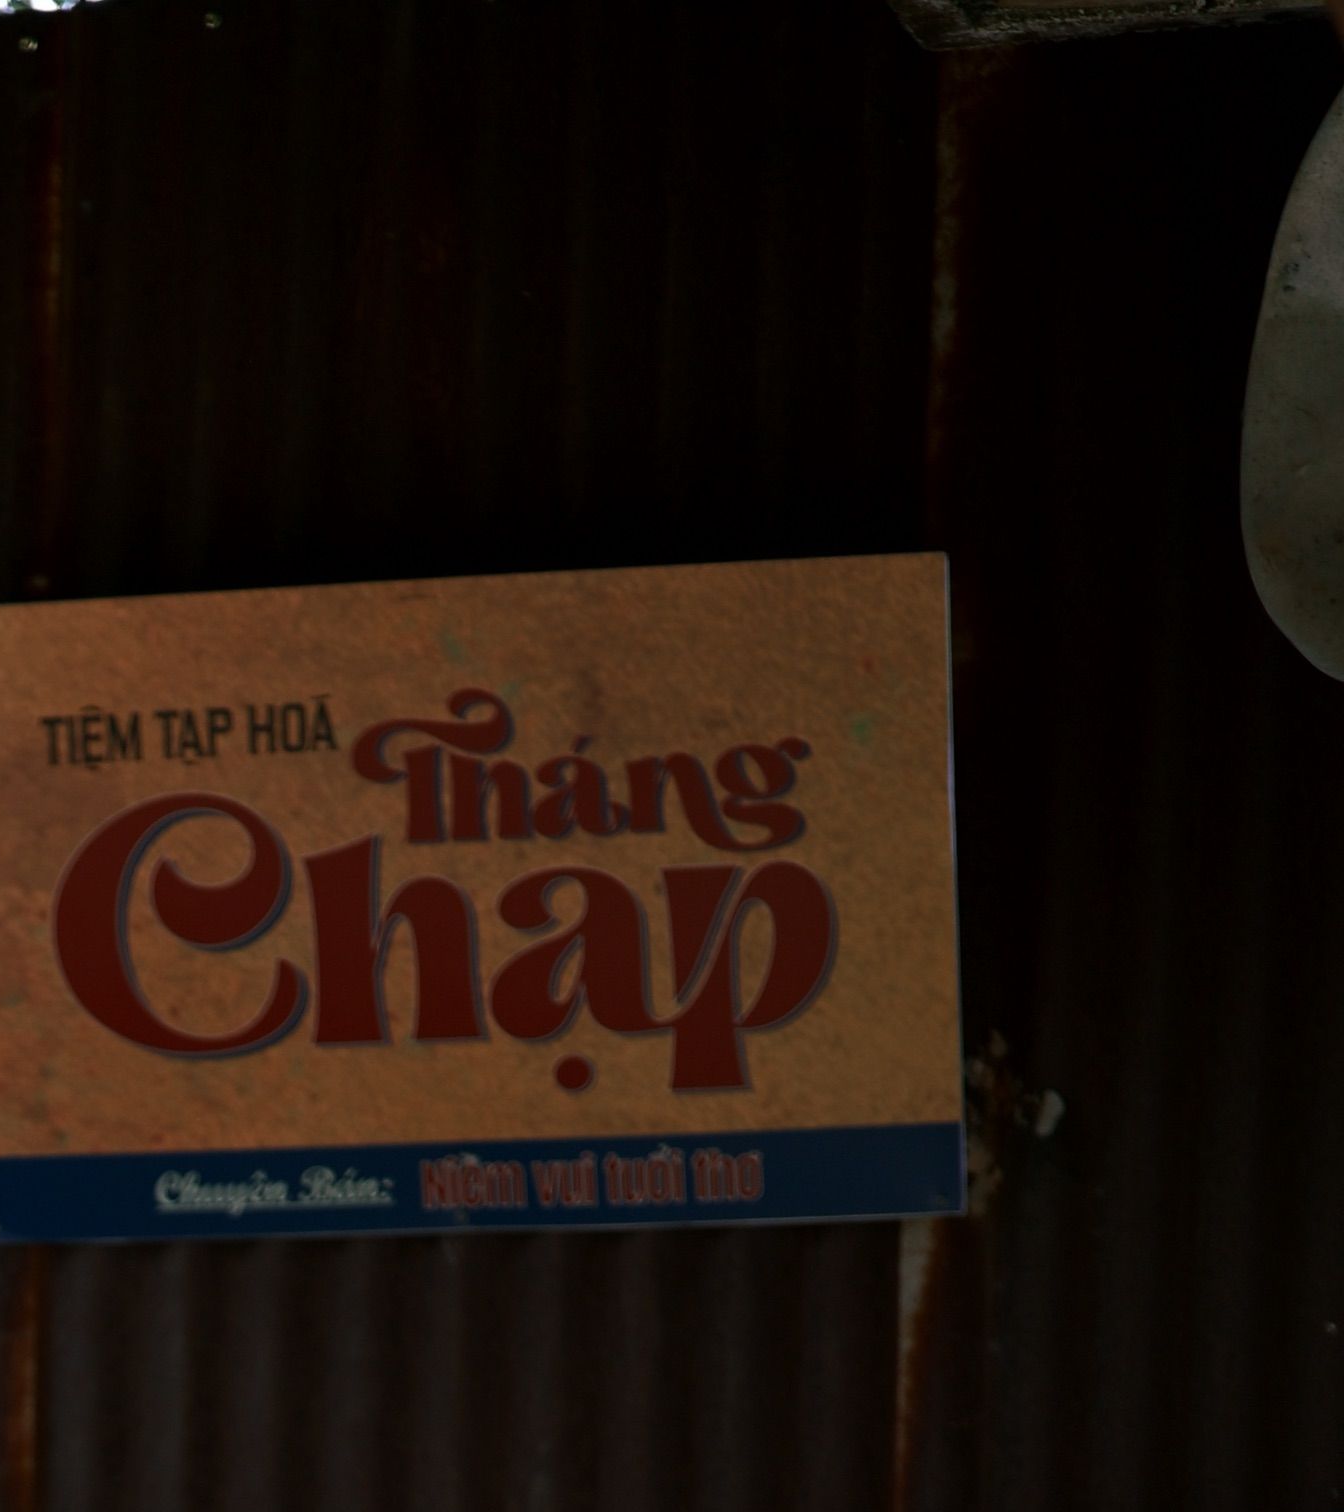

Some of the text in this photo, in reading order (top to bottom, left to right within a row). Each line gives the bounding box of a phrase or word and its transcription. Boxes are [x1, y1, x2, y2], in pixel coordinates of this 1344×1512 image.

[43, 692, 337, 768] TIỆM TẠP HOÁ
[352, 687, 810, 852] Tháng
[52, 791, 838, 1093] Chạp
[531, 1152, 598, 1208] vui
